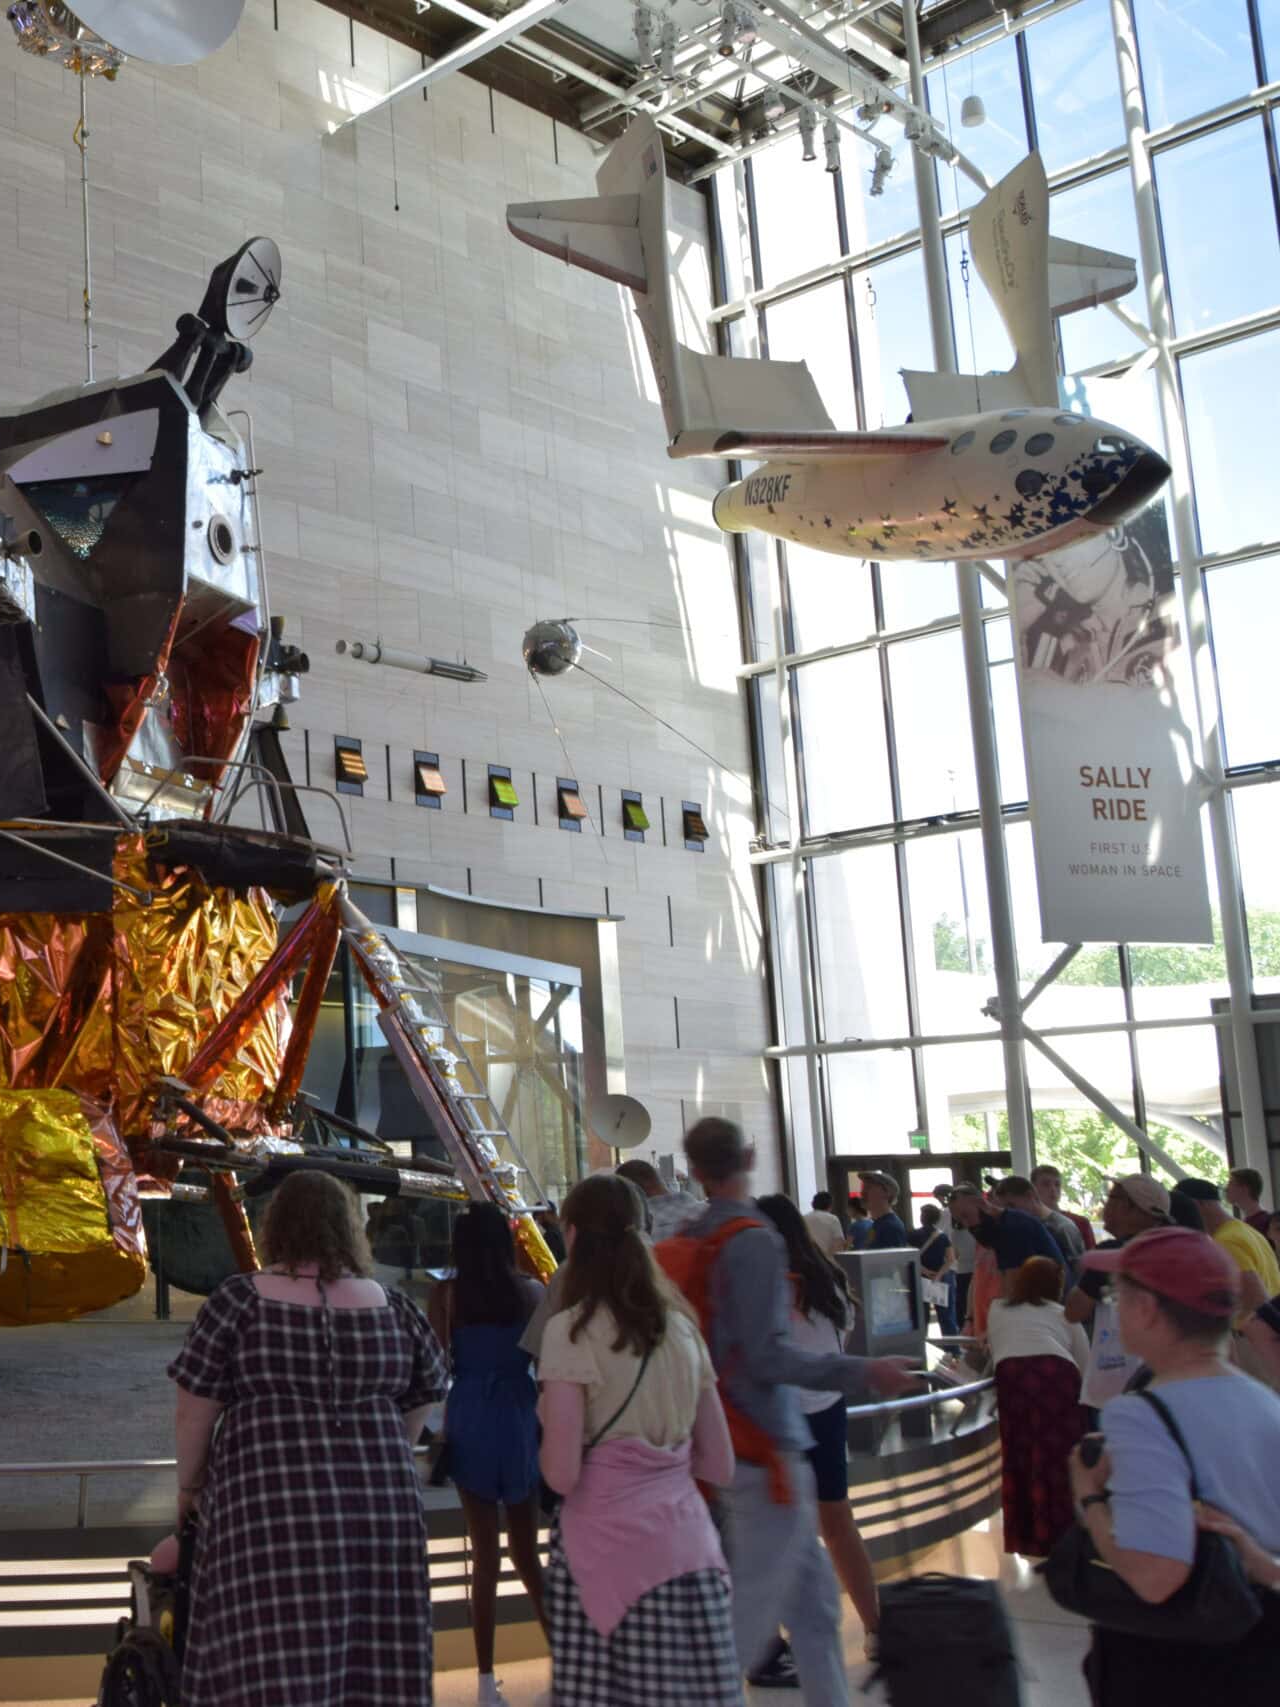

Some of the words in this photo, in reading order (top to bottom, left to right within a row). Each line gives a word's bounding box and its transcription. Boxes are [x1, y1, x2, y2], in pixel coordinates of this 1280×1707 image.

[744, 474, 792, 506] N328KF
[1079, 766, 1151, 789] SALLY
[1091, 798, 1148, 821] RIDE
[1089, 842, 1126, 855] FIRST
[1069, 864, 1118, 876] WOMAN
[1123, 865, 1136, 876] IN
[1142, 865, 1183, 878] SPACE
